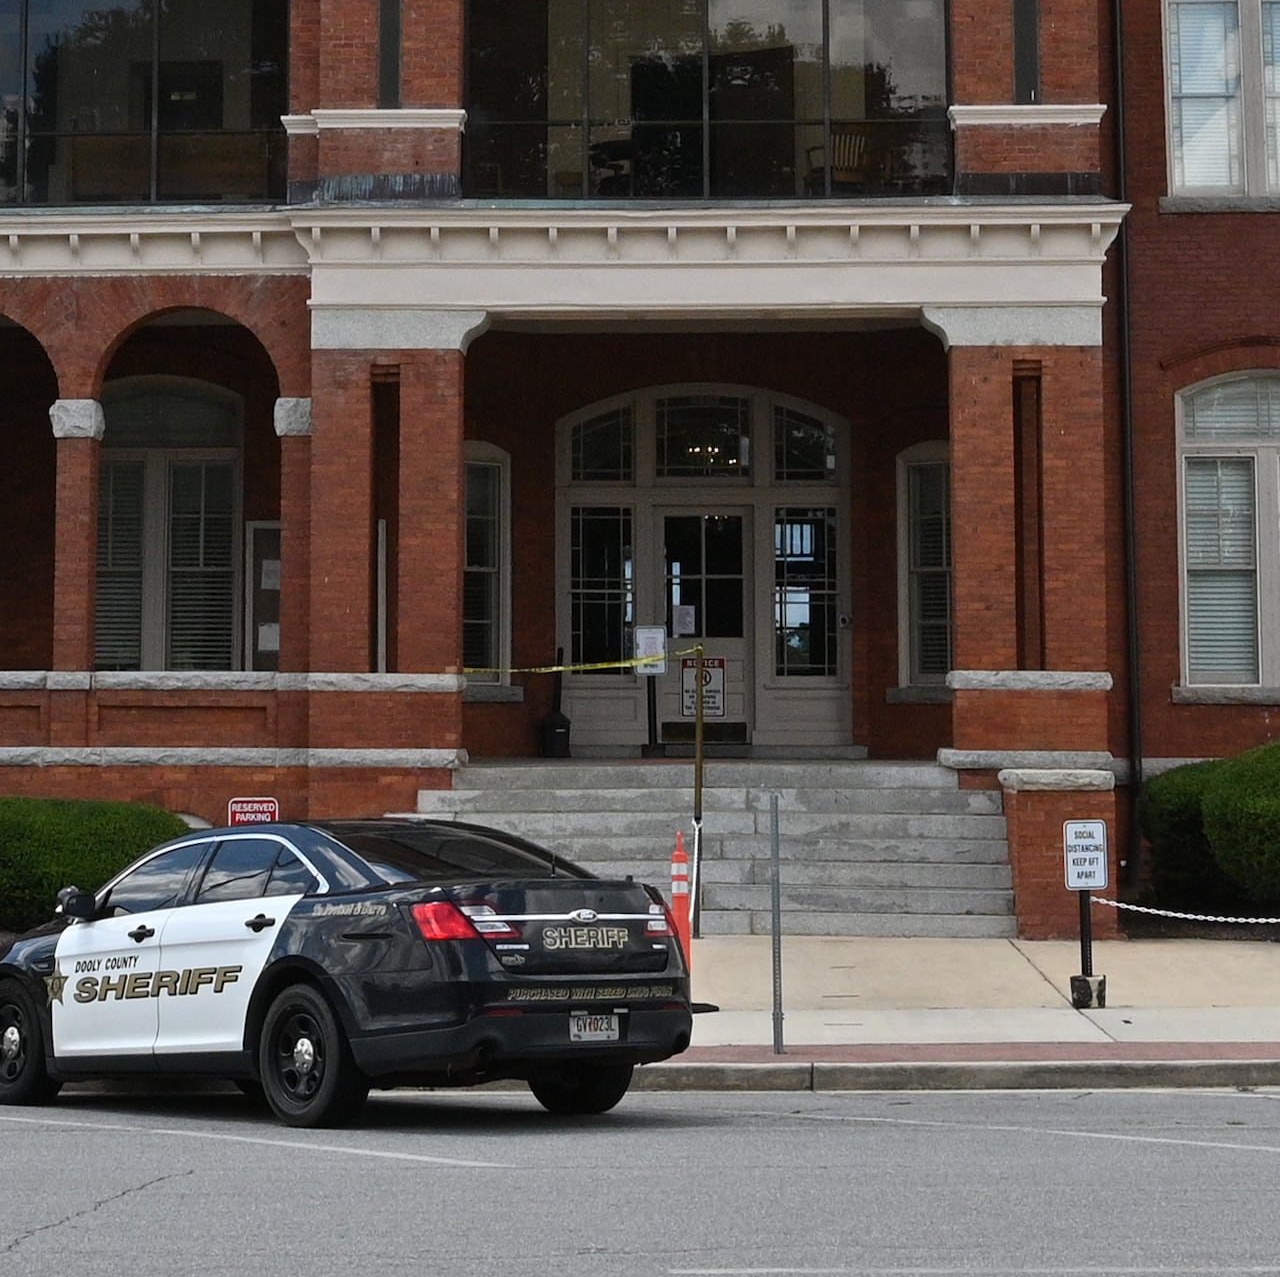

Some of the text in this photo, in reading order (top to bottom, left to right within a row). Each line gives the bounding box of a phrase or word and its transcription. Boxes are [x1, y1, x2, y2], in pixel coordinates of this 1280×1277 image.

[231, 802, 275, 812] RESERVED
[235, 812, 271, 822] PARKING
[1074, 830, 1096, 839] SOCIAL
[1068, 844, 1104, 853] DISTANCING
[1072, 857, 1099, 867] KEEP 6FT
[1076, 870, 1096, 880] APART
[542, 926, 629, 950] SHERIFF
[75, 955, 140, 973] DOOLY COUNTY
[73, 965, 243, 1004] SHERIFF
[507, 987, 571, 1001] PURCHASED
[570, 987, 595, 1000] WITH
[595, 987, 626, 1000] SEIZED
